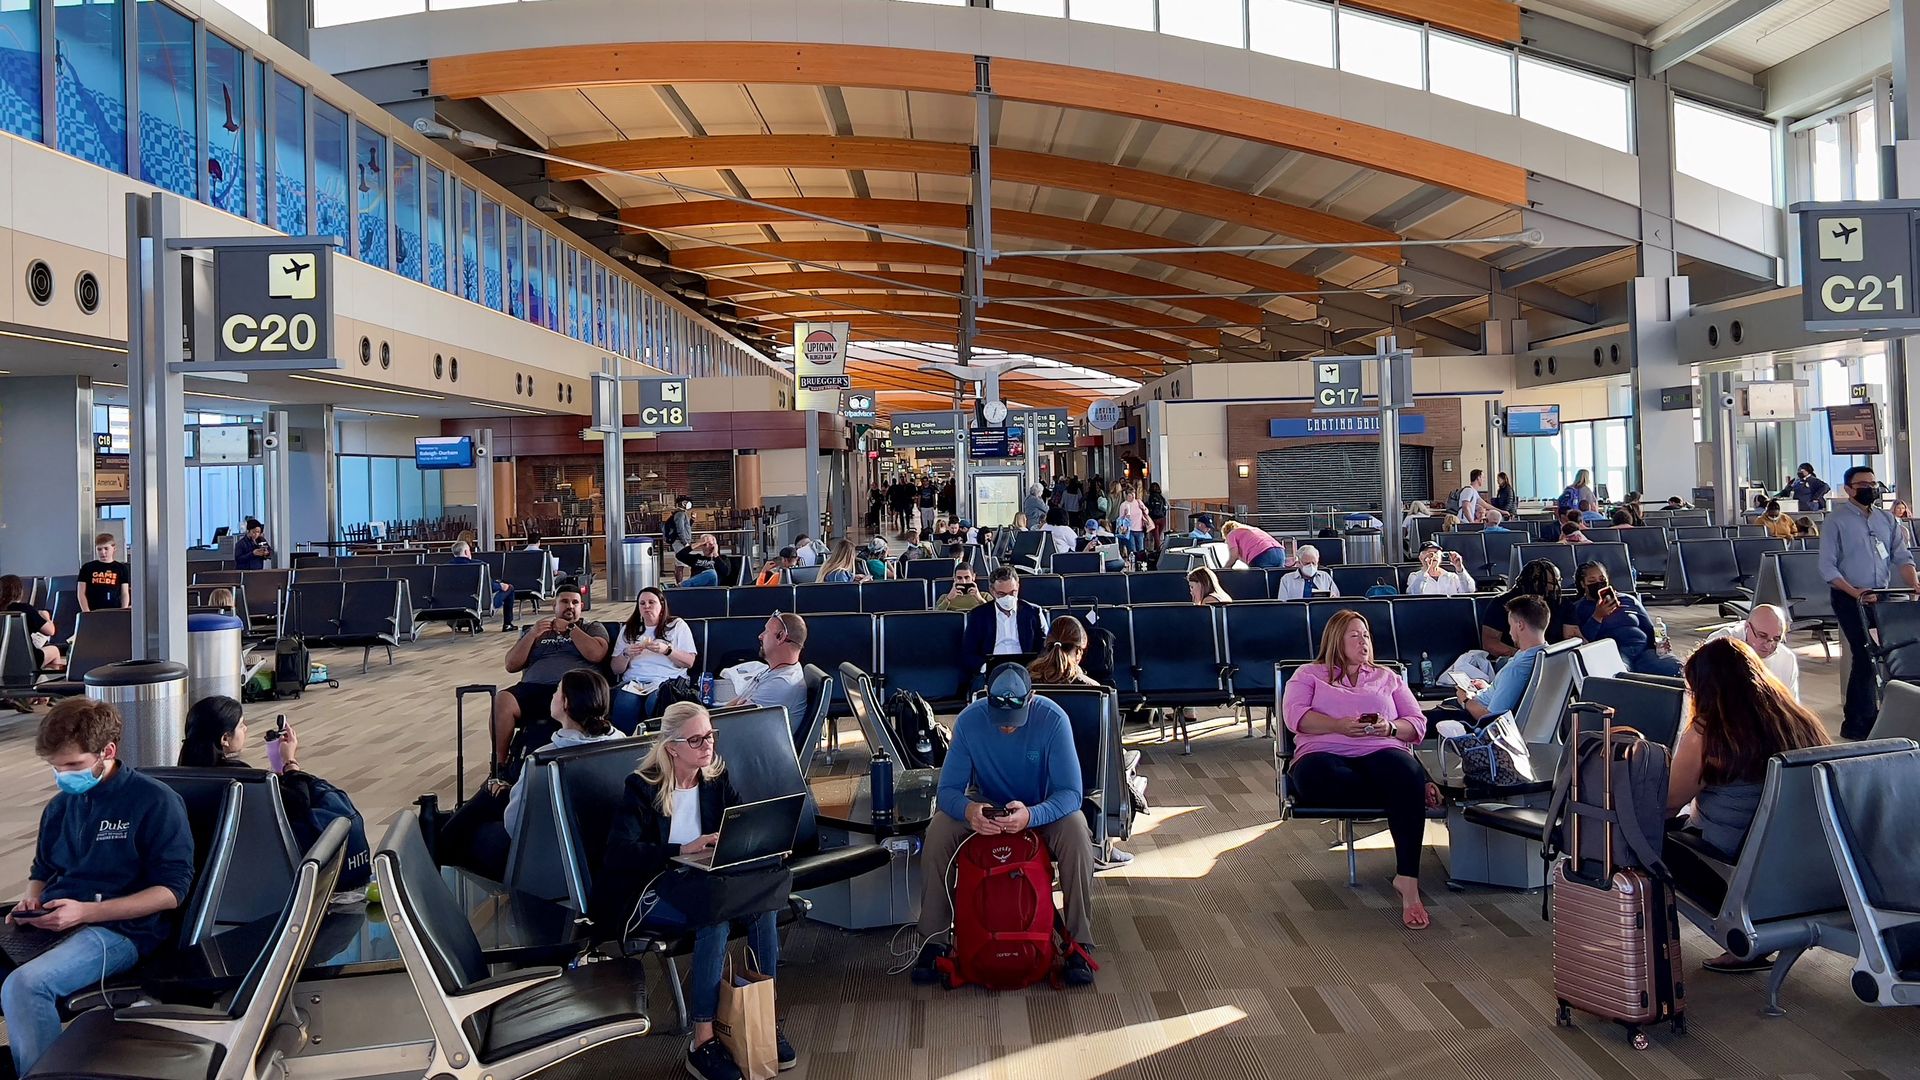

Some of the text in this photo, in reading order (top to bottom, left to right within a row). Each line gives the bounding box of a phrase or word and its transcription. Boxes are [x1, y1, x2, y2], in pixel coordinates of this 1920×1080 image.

[1821, 275, 1904, 313] C21
[222, 313, 317, 353] C20
[807, 343, 834, 352] UPTOWN
[801, 376, 849, 387] BRUEGGER'S
[1320, 388, 1359, 406] C17
[1852, 386, 1866, 396] C17
[642, 407, 683, 425] C18
[1307, 417, 1380, 431] CANTINA GRIL
[98, 435, 111, 445] C18
[92, 571, 117, 579] GAME
[99, 819, 130, 832] Duke
